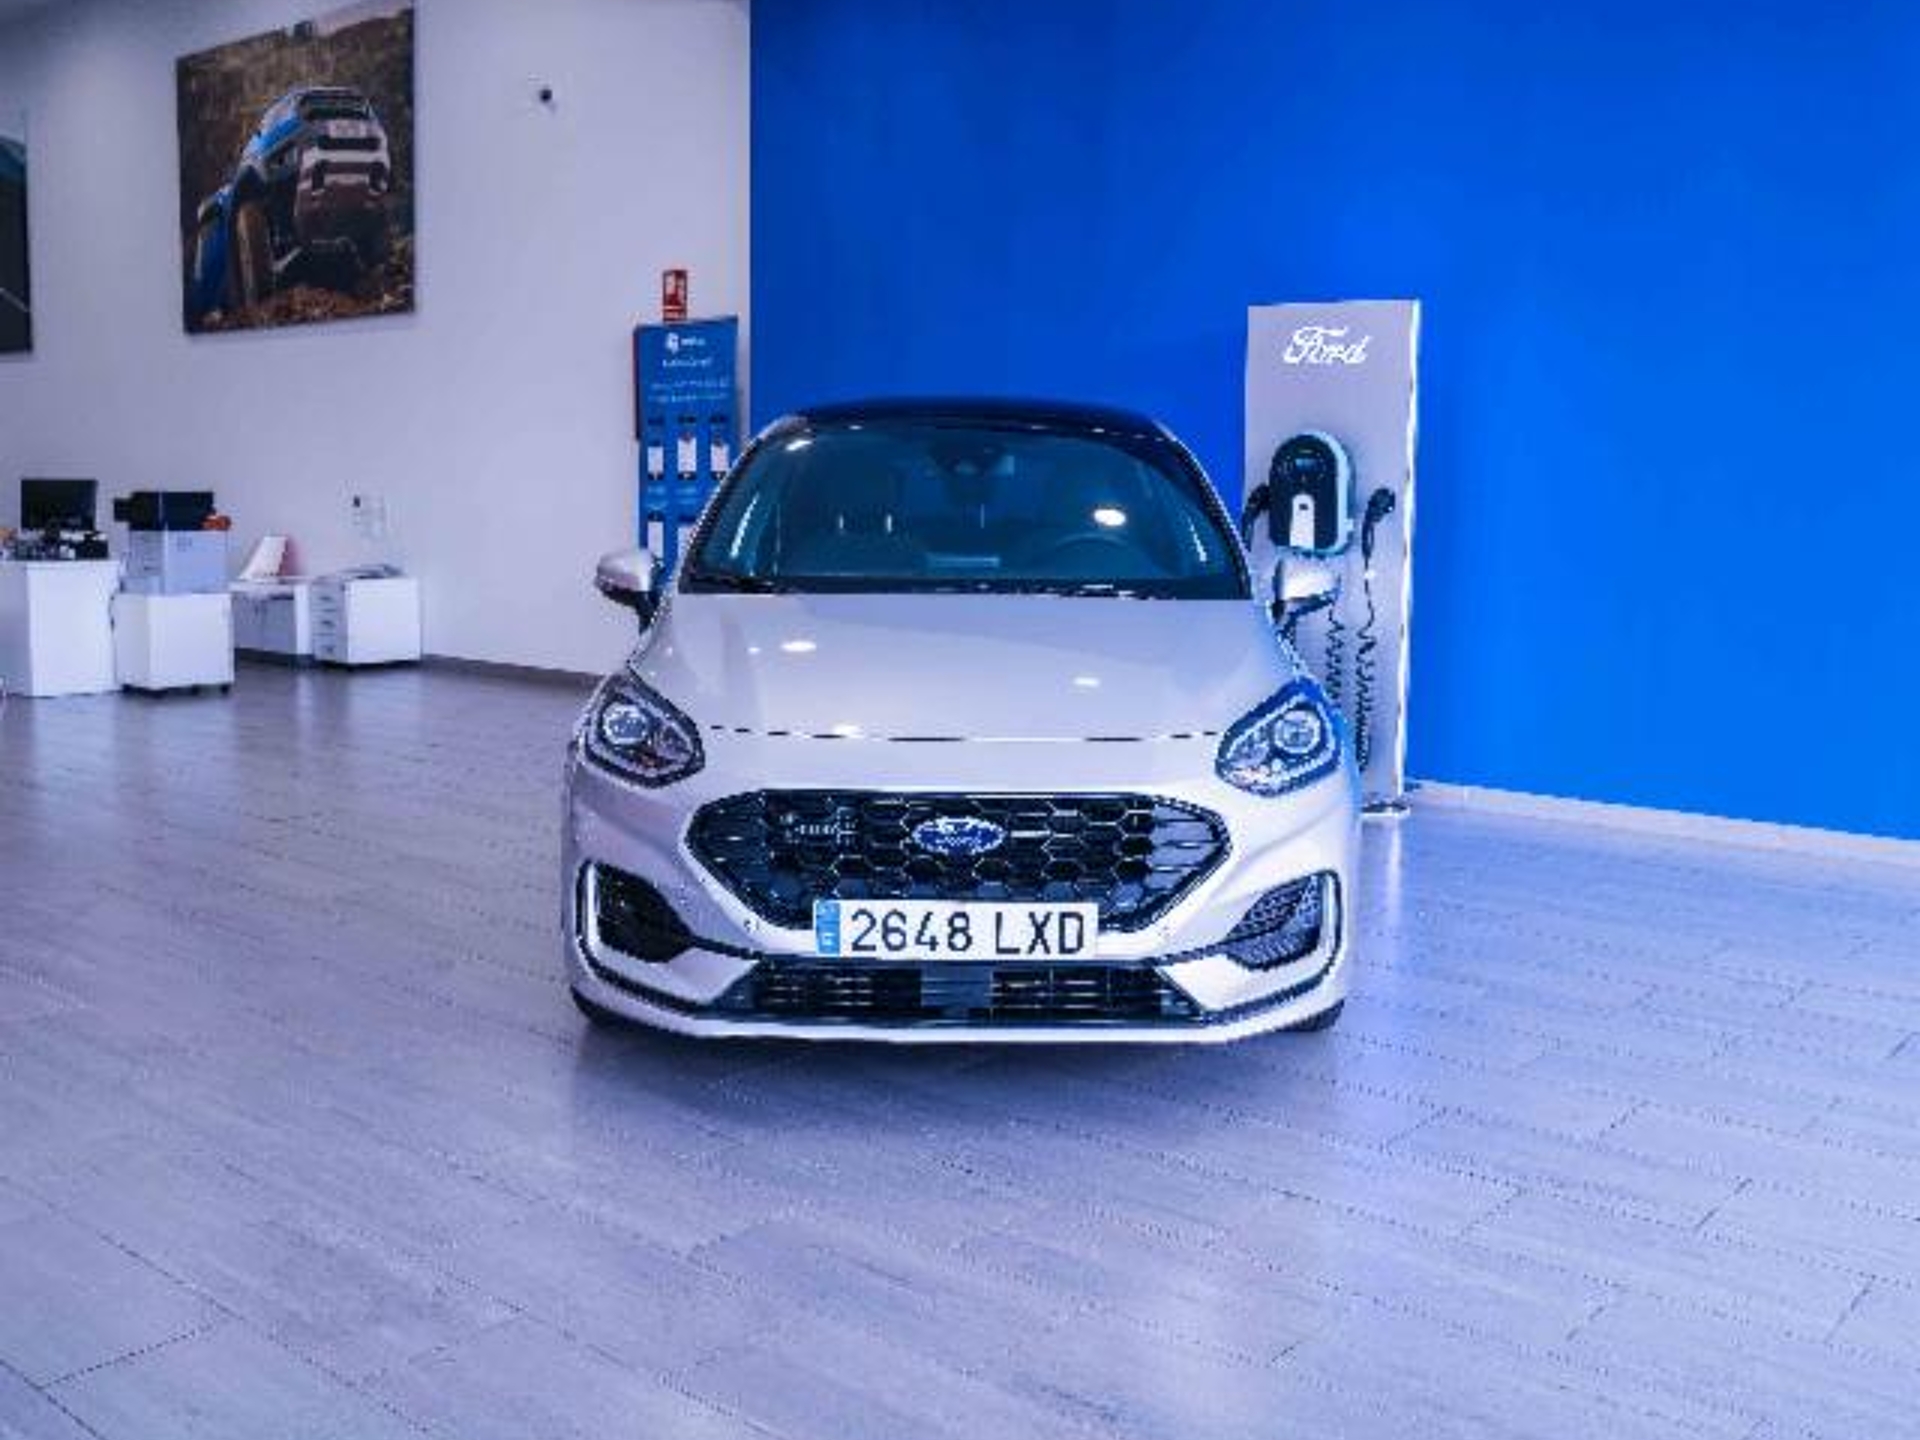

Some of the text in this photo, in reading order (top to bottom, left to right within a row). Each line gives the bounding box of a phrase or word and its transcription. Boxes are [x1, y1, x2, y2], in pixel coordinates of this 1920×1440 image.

[1284, 326, 1371, 364] Ford
[851, 908, 1084, 954] 2648 LXD
